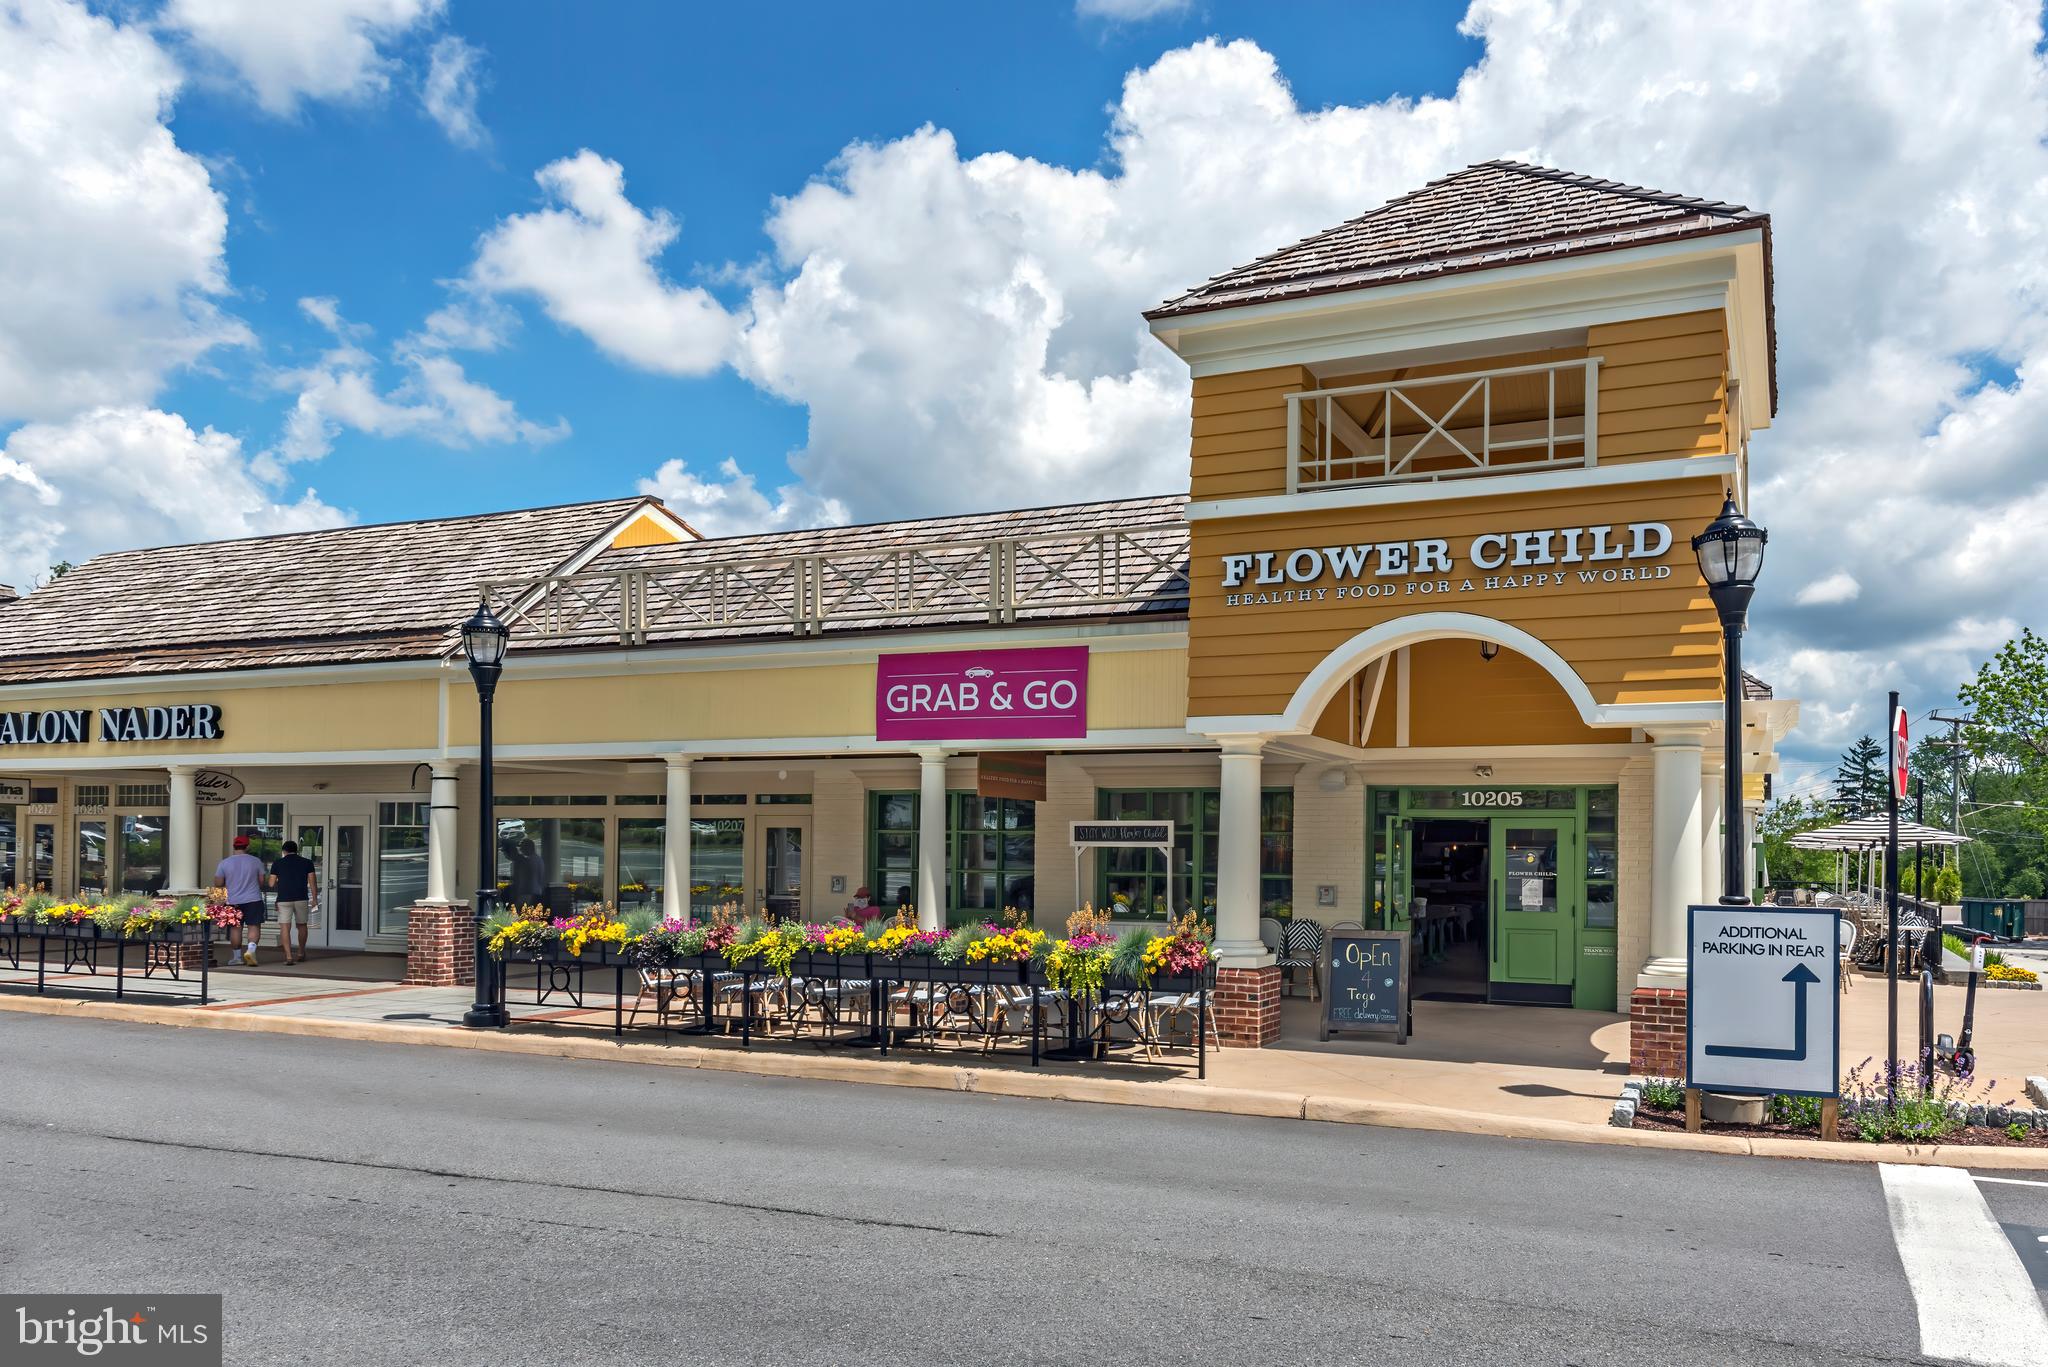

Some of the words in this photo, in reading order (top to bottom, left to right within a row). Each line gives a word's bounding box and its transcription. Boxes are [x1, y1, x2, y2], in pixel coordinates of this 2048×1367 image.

[1221, 539, 1453, 587] FLOWER
[1470, 522, 1673, 570] CHILD
[1226, 588, 1328, 606] HEALTHY
[1336, 583, 1396, 599] FOOD
[1405, 580, 1450, 595] FOR
[1459, 579, 1475, 592] A
[1485, 572, 1567, 590] HAPPY
[1577, 565, 1672, 584] WORLD
[886, 683, 980, 713] GRAB
[989, 681, 1014, 710] &
[1023, 680, 1078, 710] GO
[0, 710, 90, 744] ALON
[98, 704, 221, 742] NADER
[1462, 791, 1523, 806] 10205
[1718, 926, 1807, 940] ADDITIONAL
[1702, 942, 1765, 955] PARKING
[1768, 944, 1783, 956] IN
[1786, 945, 1825, 957] REAR
[1361, 970, 1373, 989] 4
